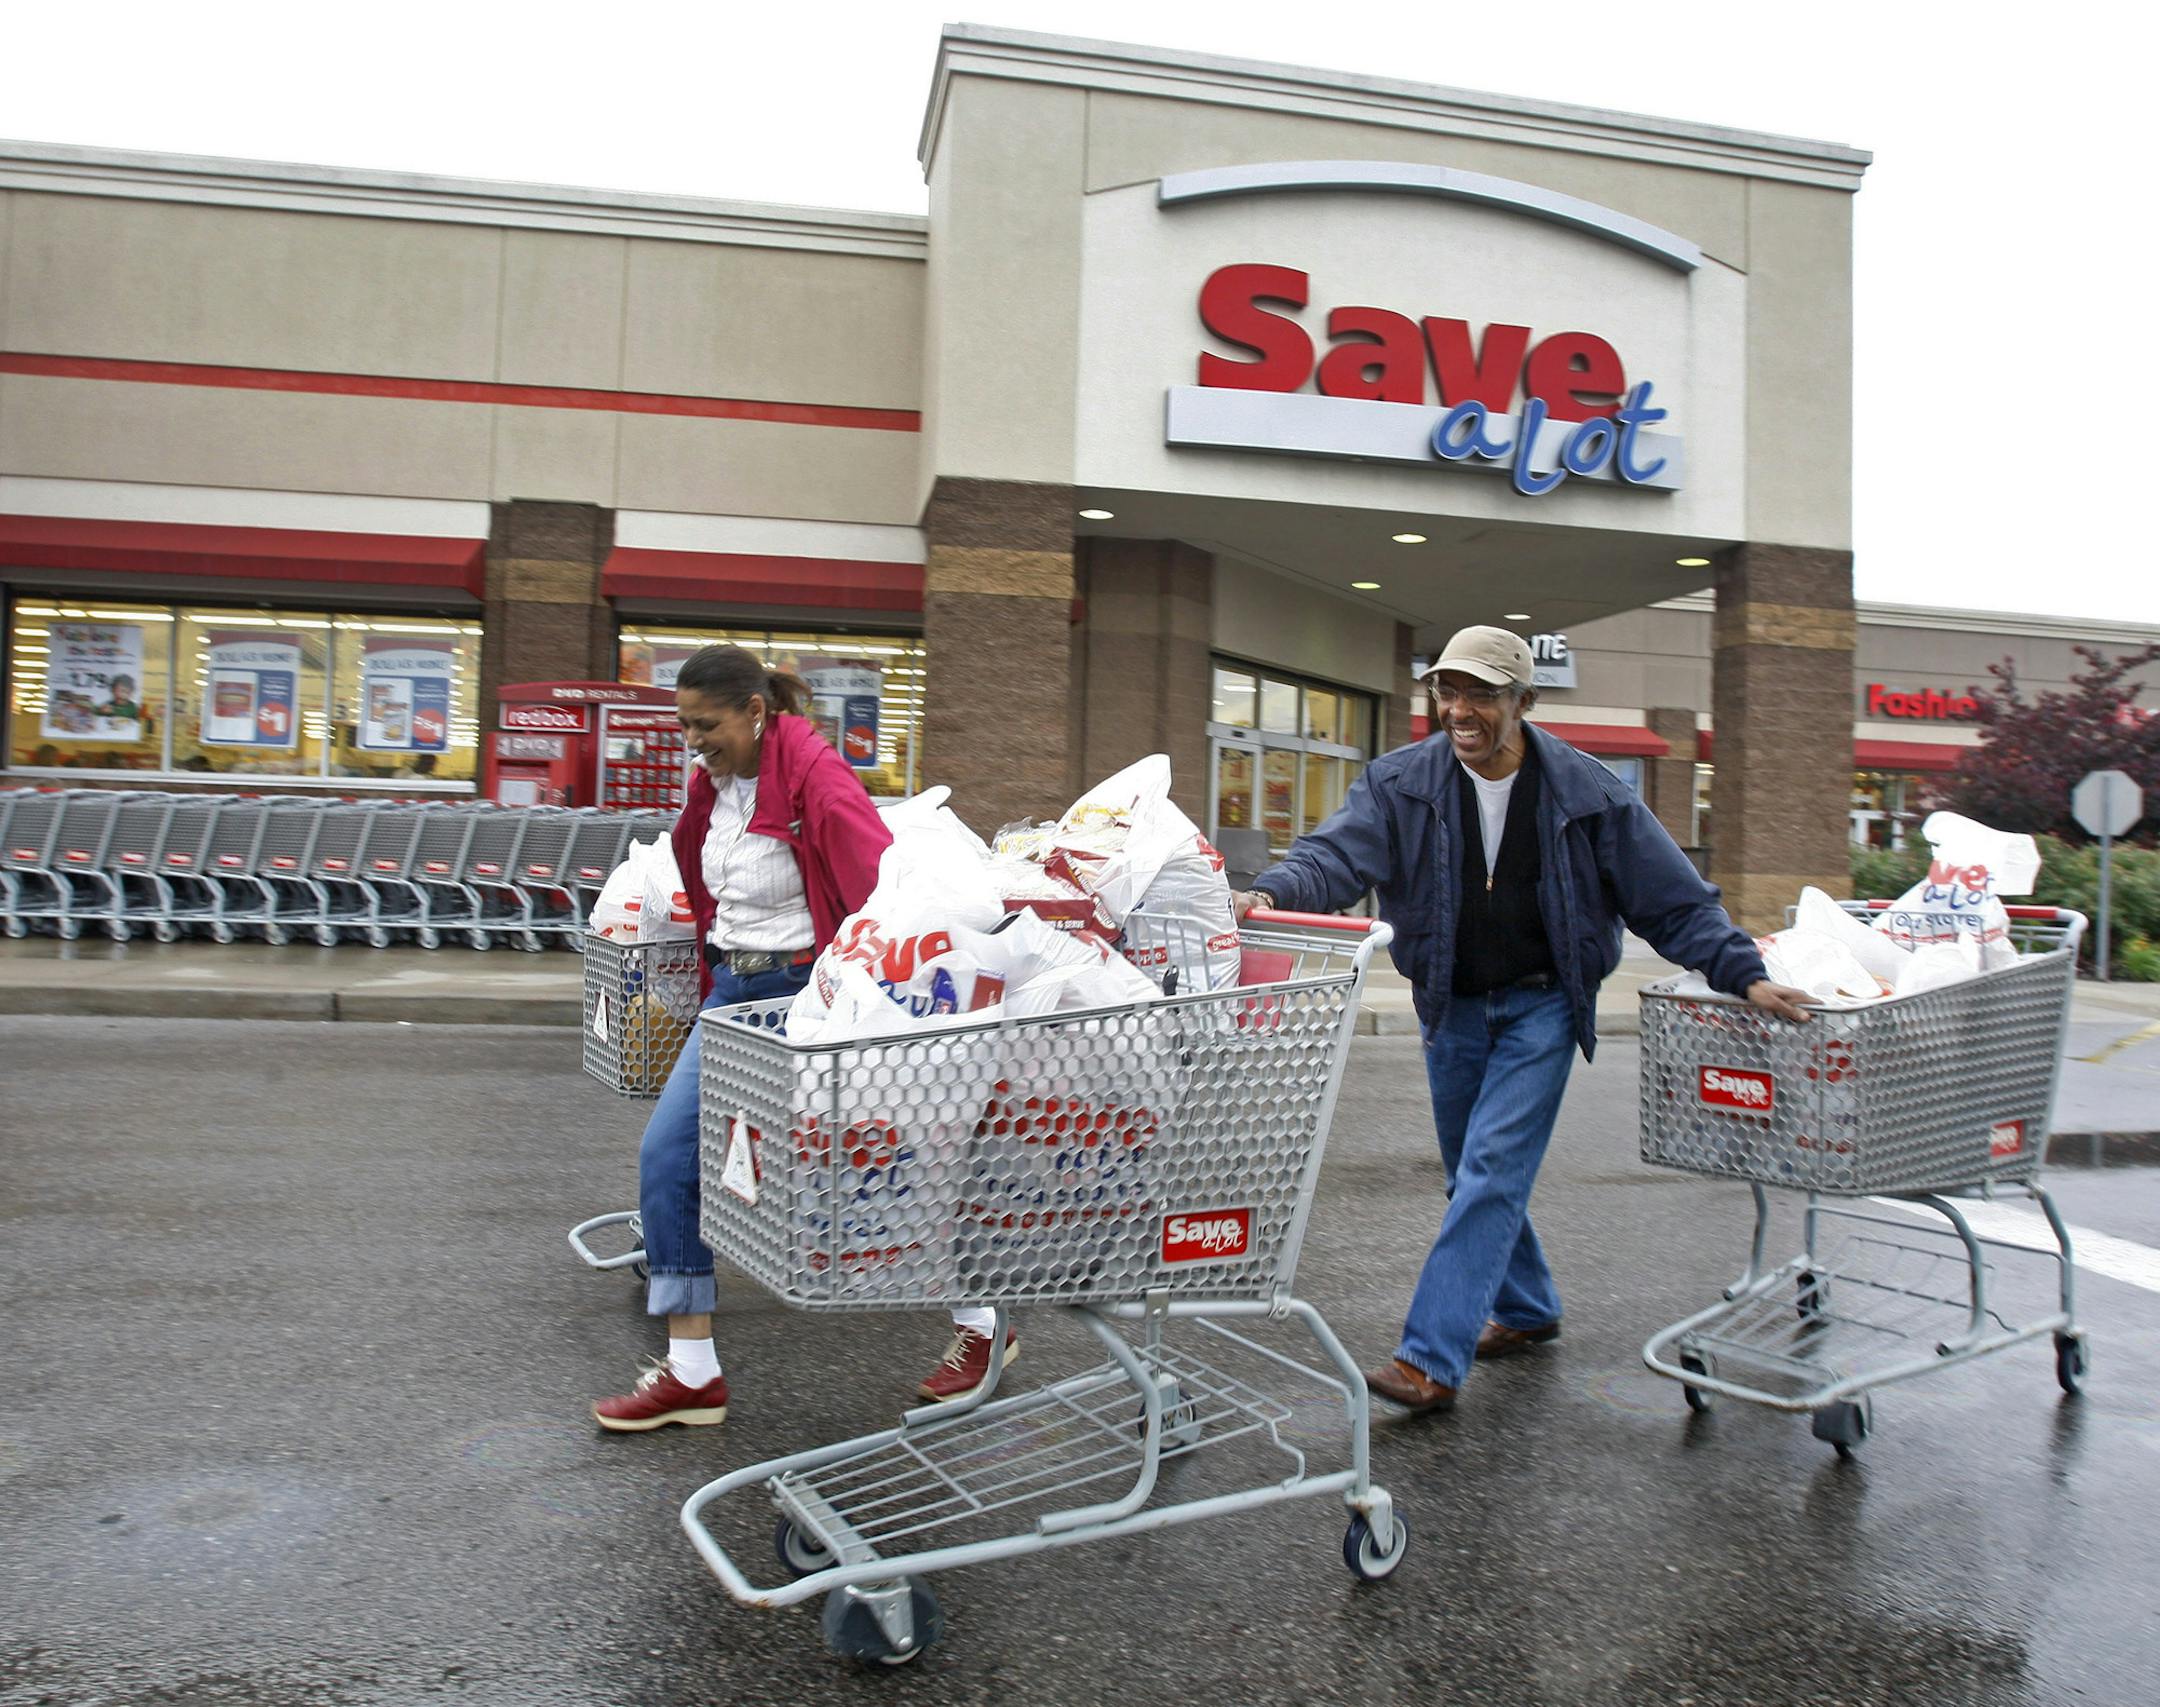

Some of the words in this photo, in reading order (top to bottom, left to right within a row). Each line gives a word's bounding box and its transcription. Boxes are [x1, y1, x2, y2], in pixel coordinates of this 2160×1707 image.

[1198, 262, 1627, 424] Save
[1867, 684, 1979, 718] Fashio
[508, 708, 580, 727] redbox
[1703, 1069, 1767, 1097] Save
[1167, 1217, 1240, 1244] Save
